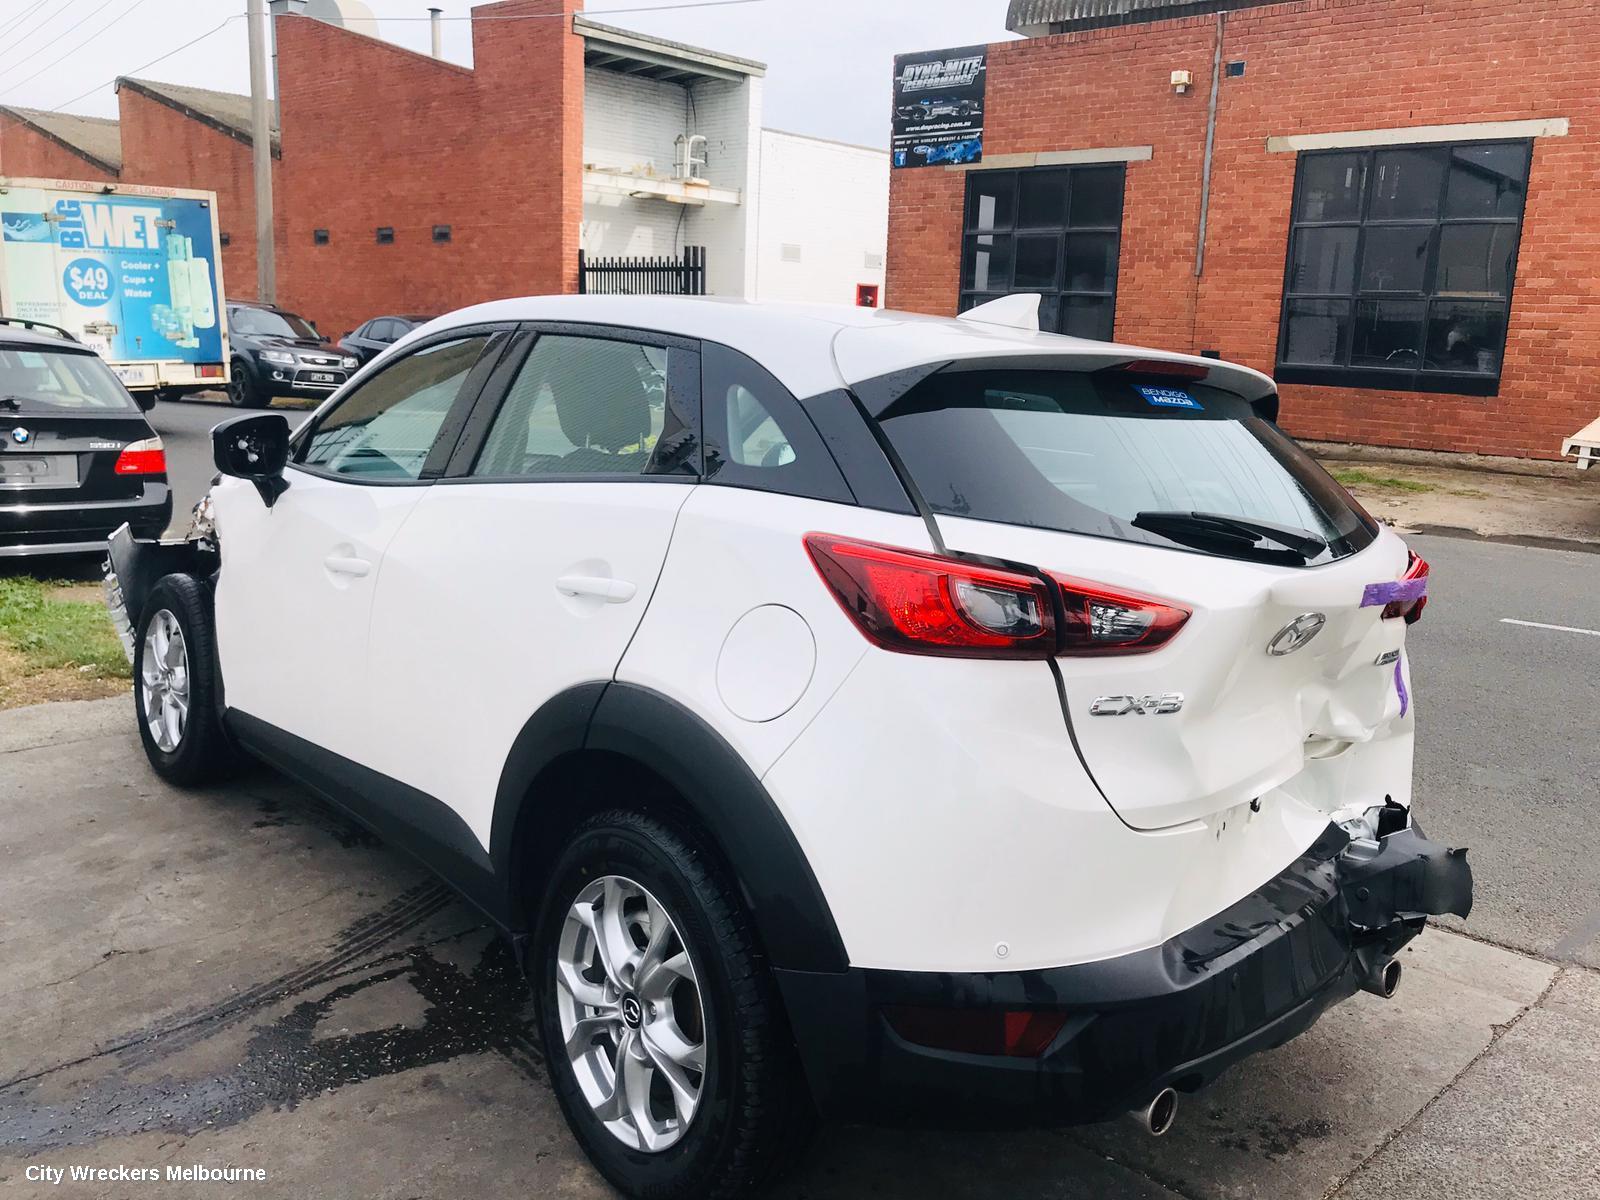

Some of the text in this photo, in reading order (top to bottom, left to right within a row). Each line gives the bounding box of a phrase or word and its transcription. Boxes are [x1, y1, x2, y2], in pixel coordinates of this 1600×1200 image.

[903, 58, 980, 81] DYNO-MITE
[905, 74, 974, 90] PERFORMANCE
[56, 200, 161, 249] BIG WET
[121, 260, 152, 270] Cooler
[69, 267, 108, 293] $49
[122, 275, 146, 285] Cups
[79, 291, 109, 300] DEAL
[124, 288, 152, 298] Water
[1141, 387, 1188, 399] BENDIGO
[1089, 692, 1185, 716] CX-3
